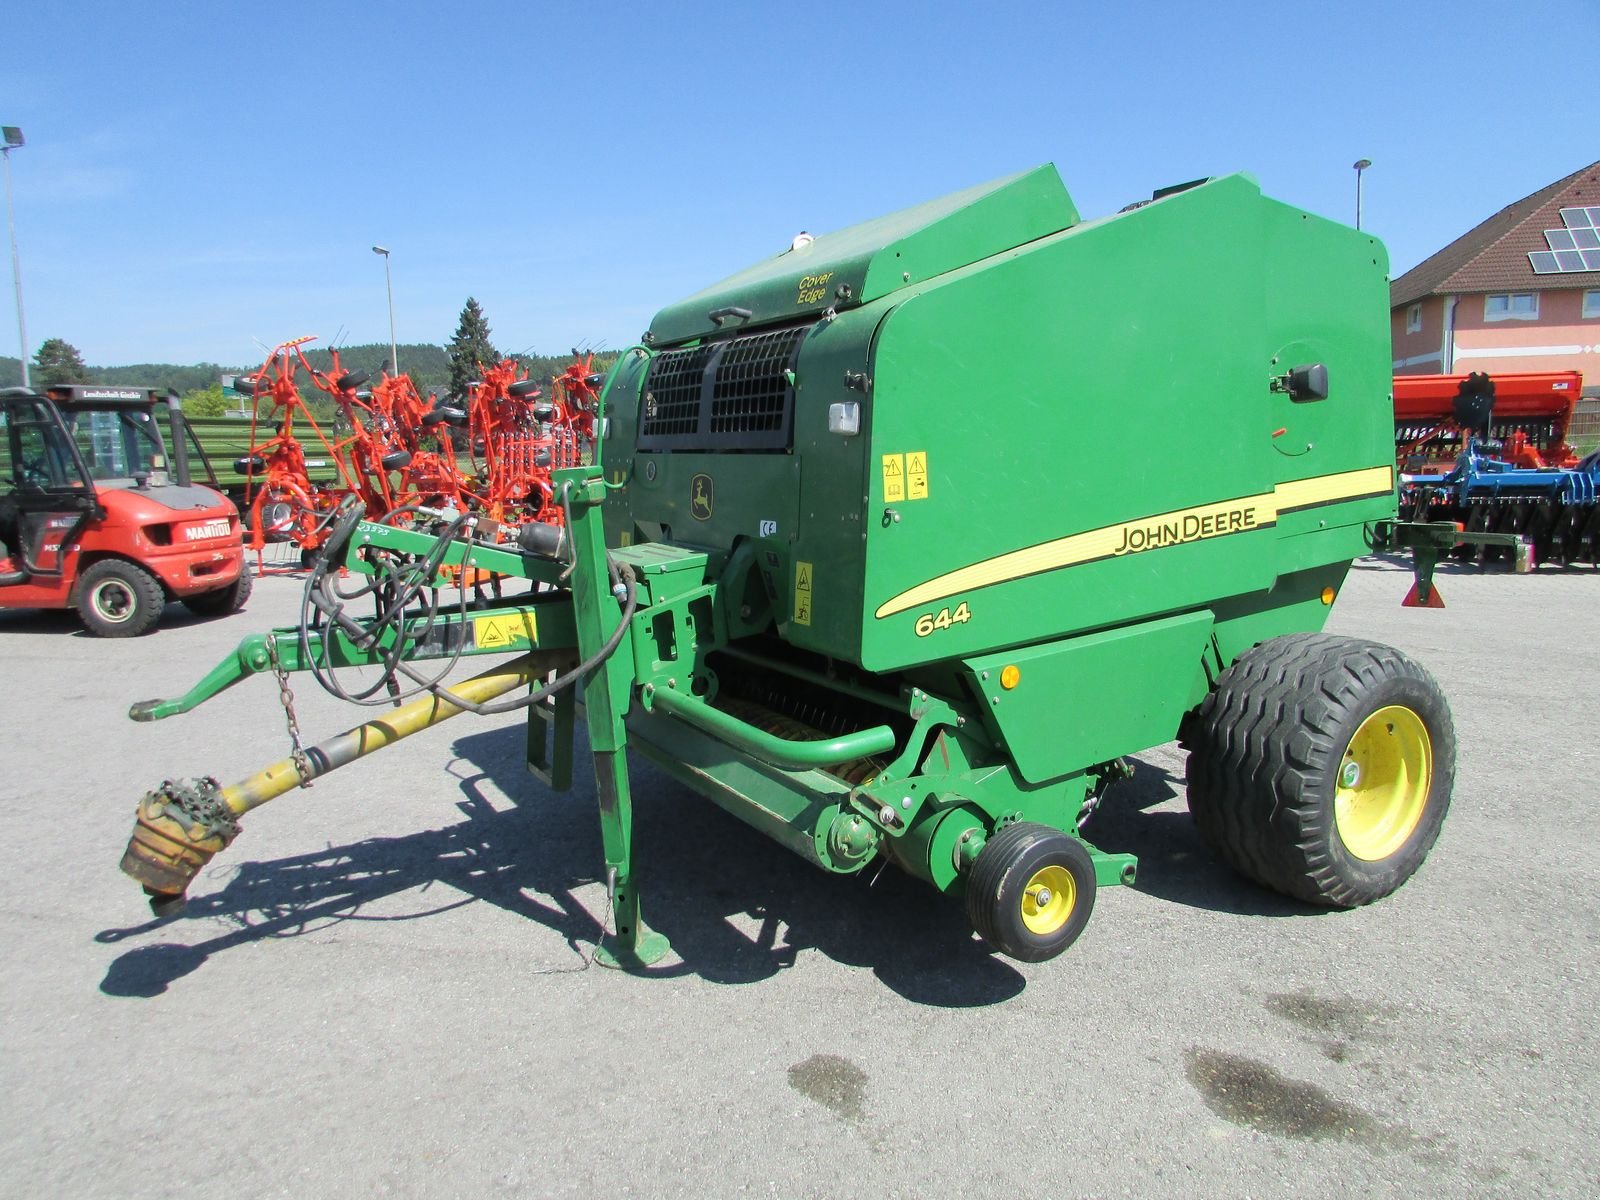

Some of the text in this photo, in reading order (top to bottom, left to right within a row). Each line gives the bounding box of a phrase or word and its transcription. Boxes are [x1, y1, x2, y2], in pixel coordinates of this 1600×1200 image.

[799, 272, 834, 289] Cover
[797, 288, 826, 304] Edge
[186, 518, 231, 541] MANITOU
[914, 601, 972, 638] 644
